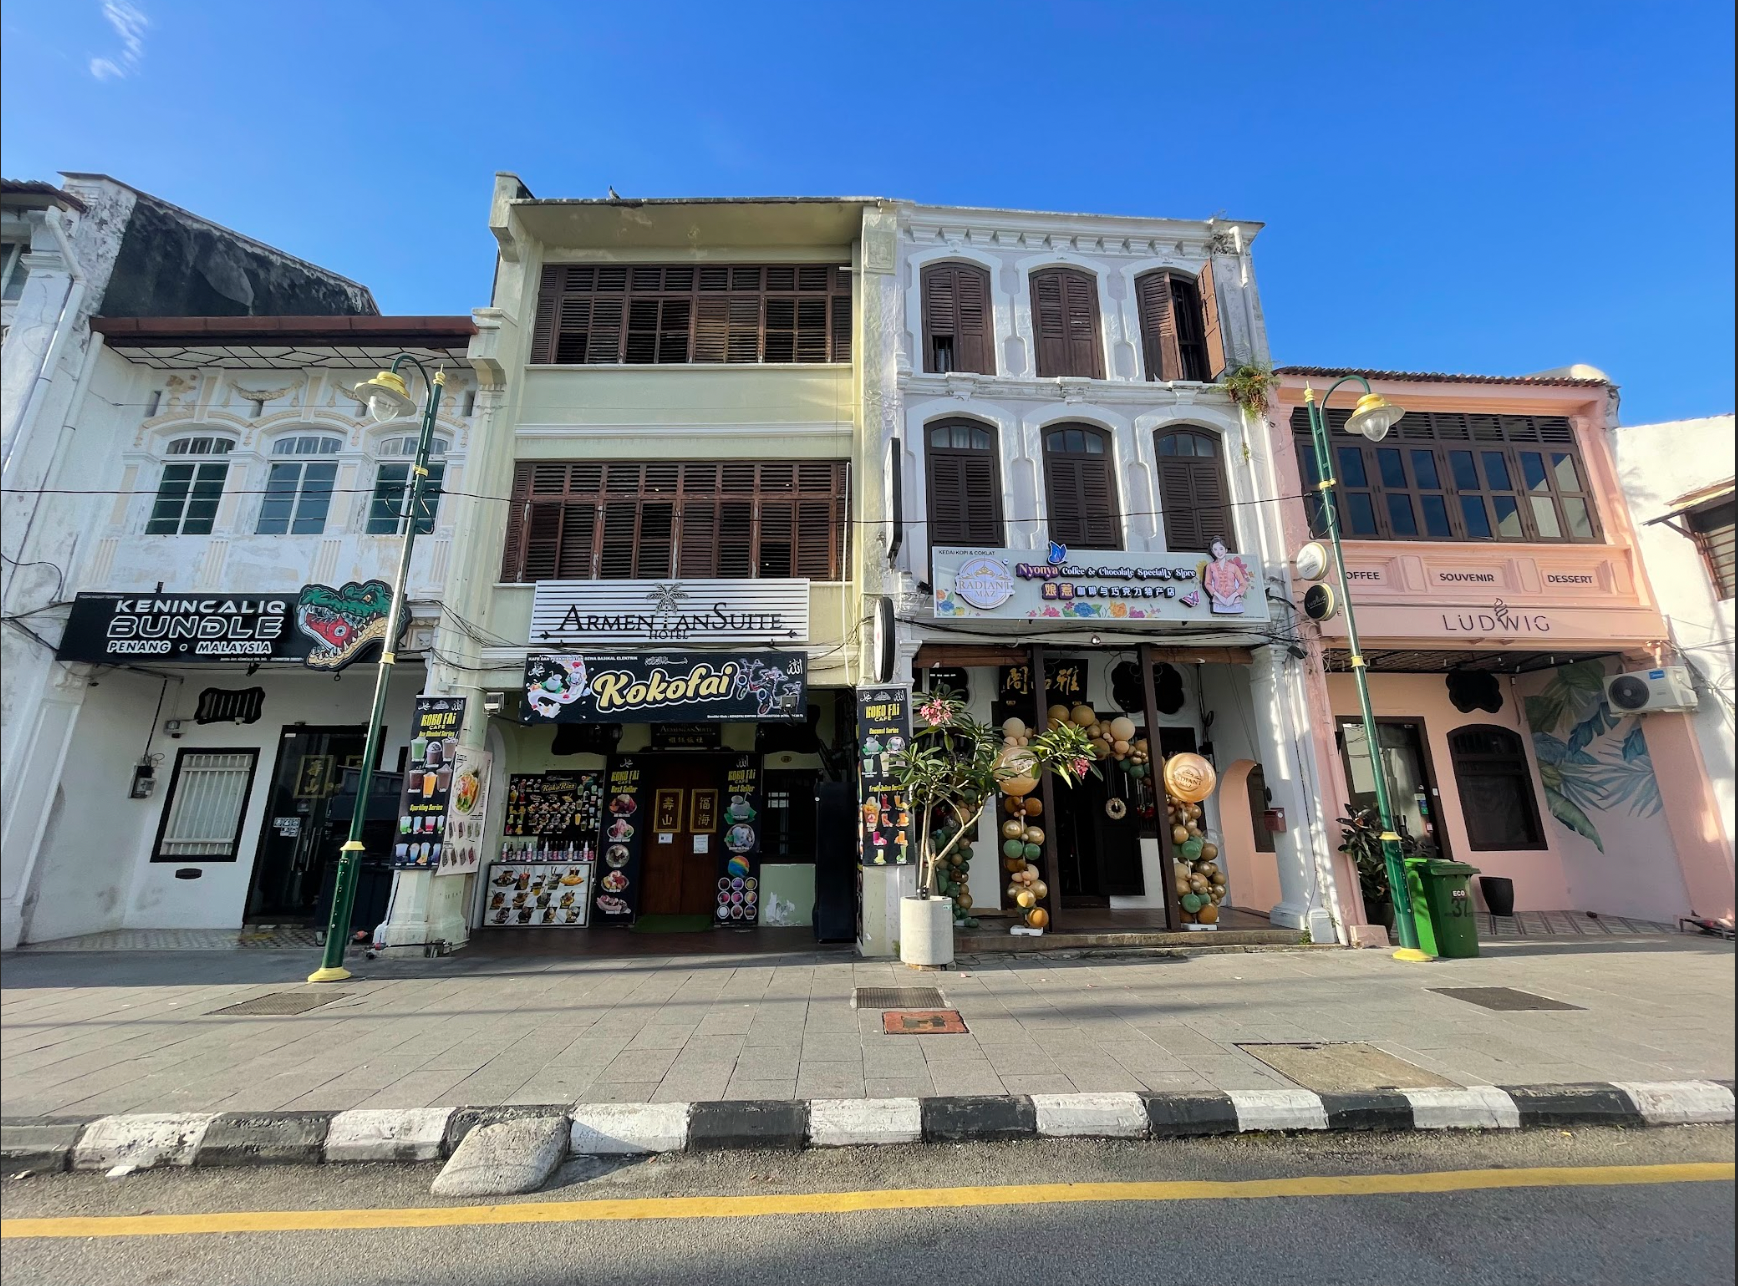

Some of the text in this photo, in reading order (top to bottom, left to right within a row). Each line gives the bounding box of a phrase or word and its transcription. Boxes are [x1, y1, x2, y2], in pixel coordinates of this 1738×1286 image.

[1017, 564, 1196, 579] Nyonya Coffee & Chocolate Specialty Store
[1346, 571, 1381, 580] OFFEE
[1439, 573, 1495, 583] SOUVENIR
[959, 580, 1012, 590] RADIANT
[1547, 574, 1594, 585] DESSERT
[115, 599, 286, 615] KENINCALIQ
[106, 615, 284, 640] BUNDLE
[1442, 614, 1550, 632] LUDWIG
[649, 629, 690, 641] HOTEL
[106, 640, 273, 655] PENANG MALAYSIA
[592, 665, 735, 708] Kokofai
[865, 704, 887, 719] KOKO
[420, 713, 443, 727] KOKO
[611, 771, 629, 782] KOKO
[728, 770, 745, 781] KOKO
[611, 785, 639, 793] Best Seller
[728, 784, 740, 793] Best
[1451, 898, 1468, 918] 37
